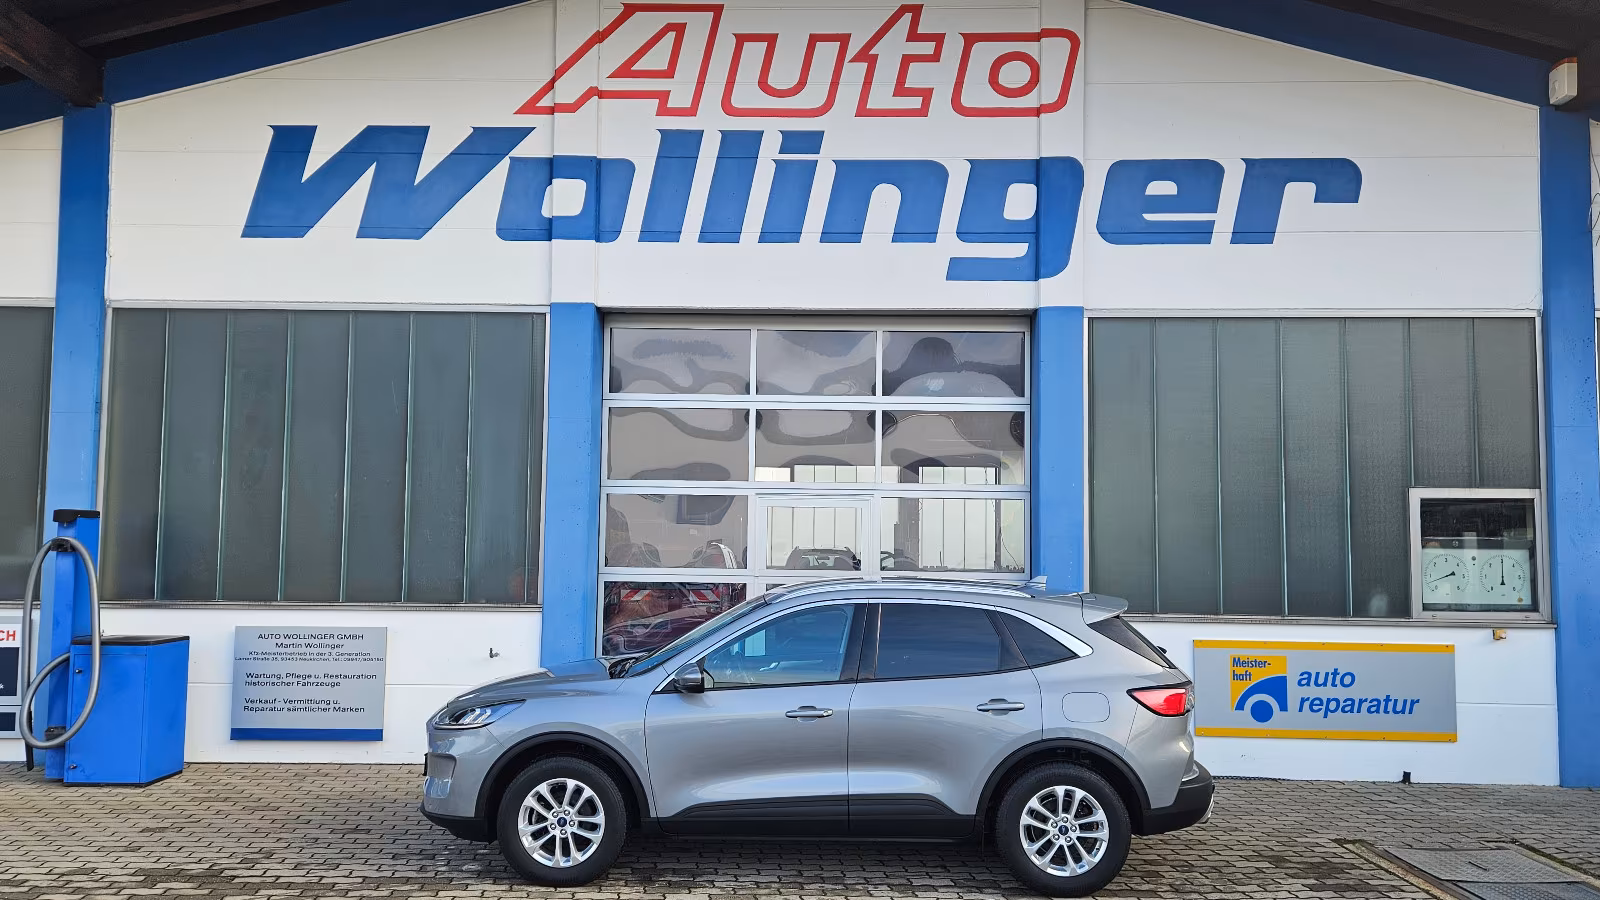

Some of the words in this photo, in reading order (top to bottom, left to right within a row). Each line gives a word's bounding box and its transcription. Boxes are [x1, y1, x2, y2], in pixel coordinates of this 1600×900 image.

[513, 2, 1081, 118] Auto
[241, 124, 1363, 281] Wollinger
[1232, 656, 1272, 669] Meister-
[1232, 670, 1252, 682] haft
[1297, 668, 1356, 688] auto
[1298, 694, 1420, 718] reparatur
